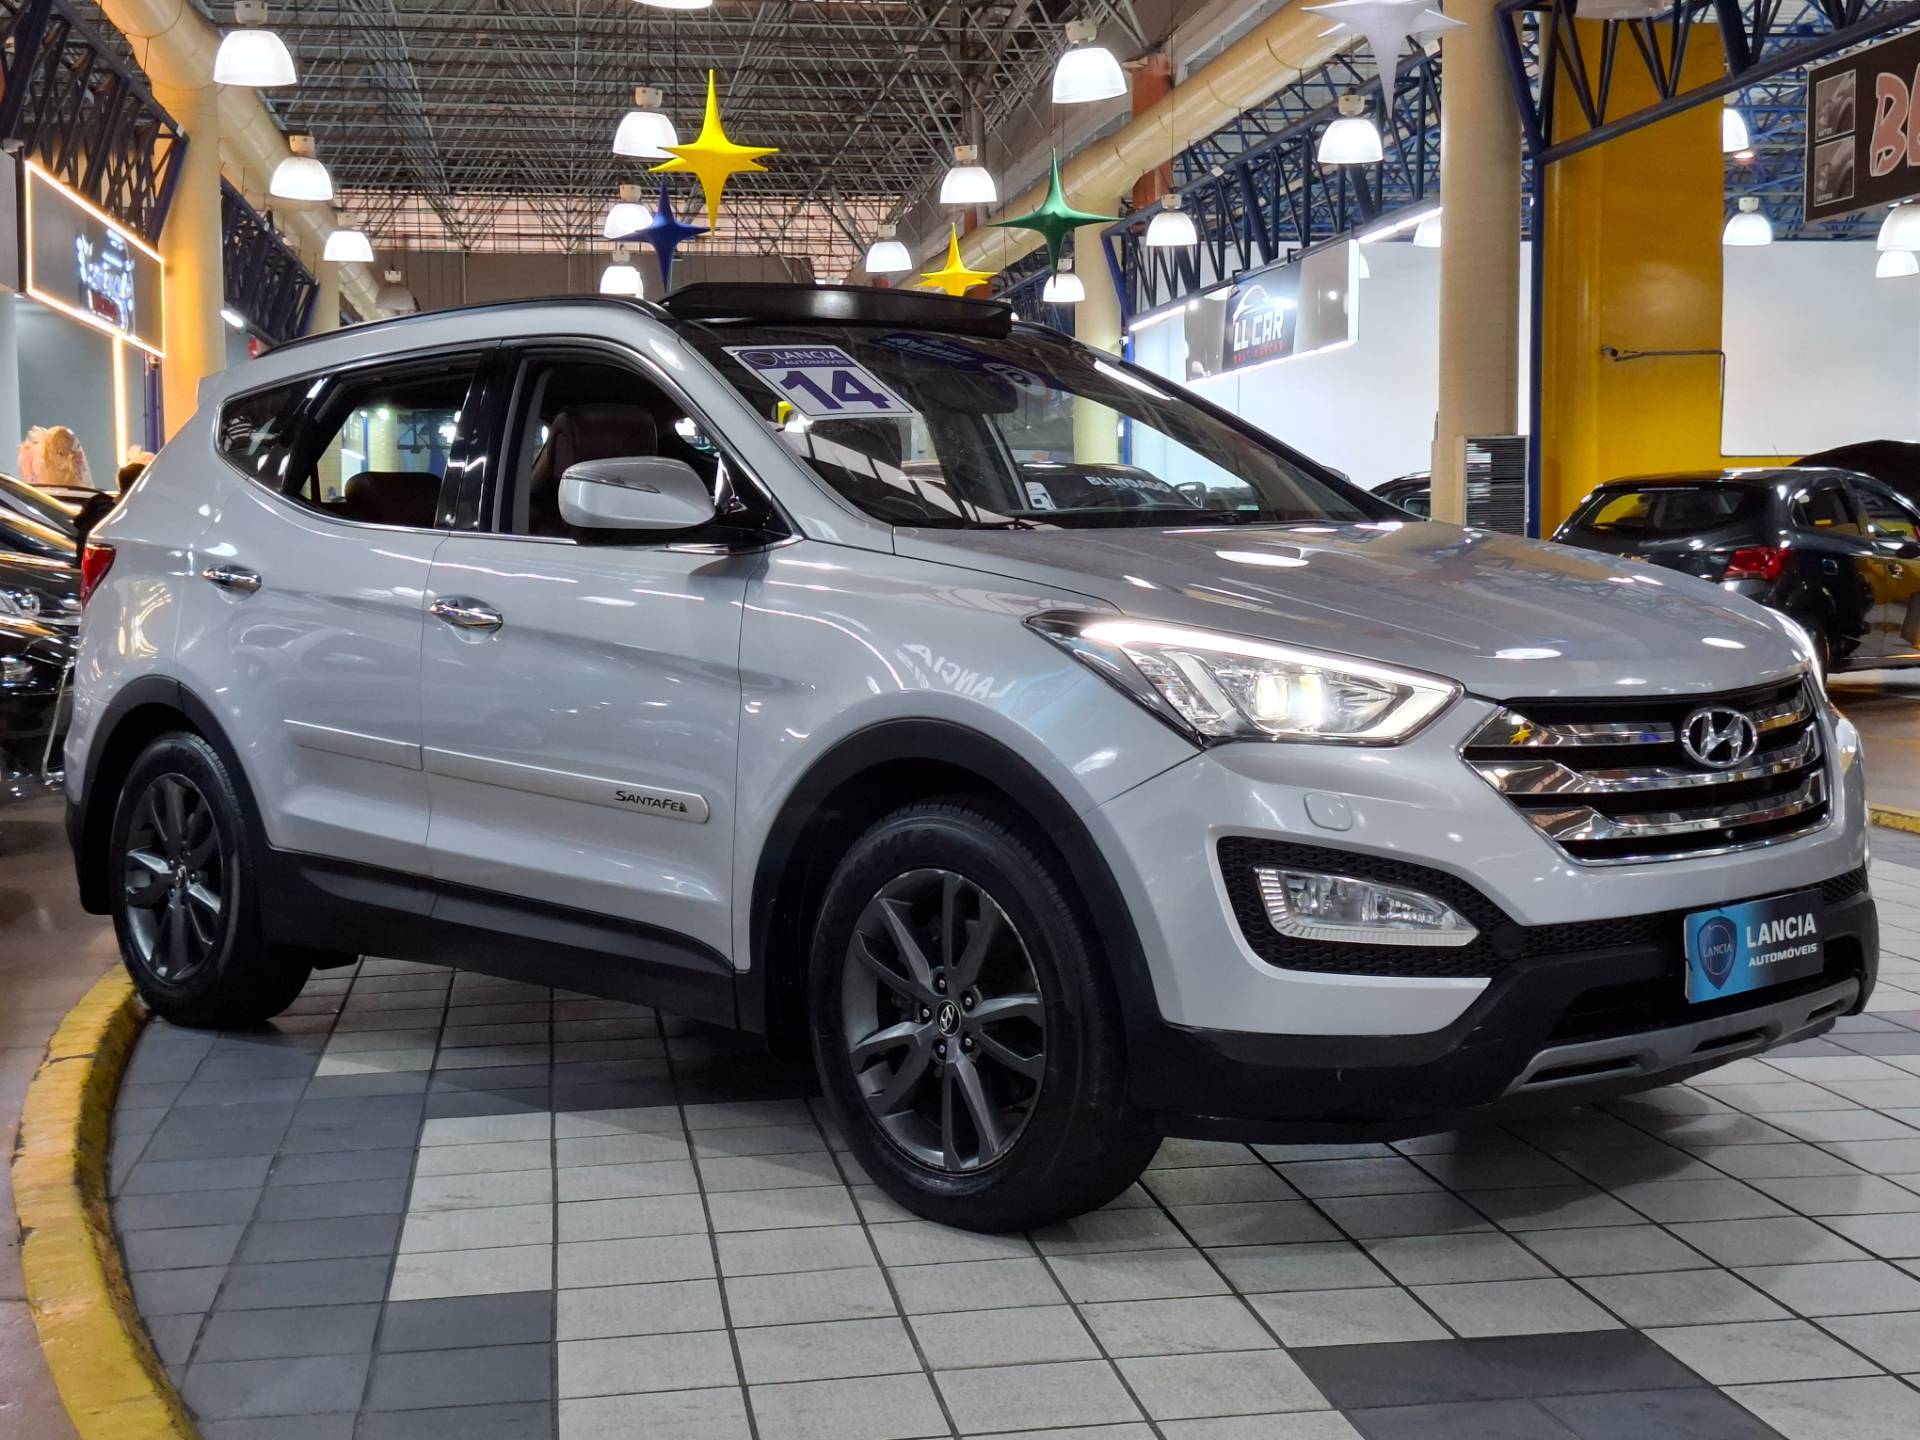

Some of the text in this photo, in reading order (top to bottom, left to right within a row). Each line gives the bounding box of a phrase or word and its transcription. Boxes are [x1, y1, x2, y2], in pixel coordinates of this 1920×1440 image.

[1252, 310, 1284, 346] CAR
[772, 351, 843, 360] LANCIA
[779, 370, 891, 409] 14
[1084, 476, 1171, 493] BLINDADO
[1746, 913, 1817, 948] LANCIA
[1703, 942, 1733, 959] LANCIA
[1748, 943, 1818, 968] AUTOMÓVEIS
